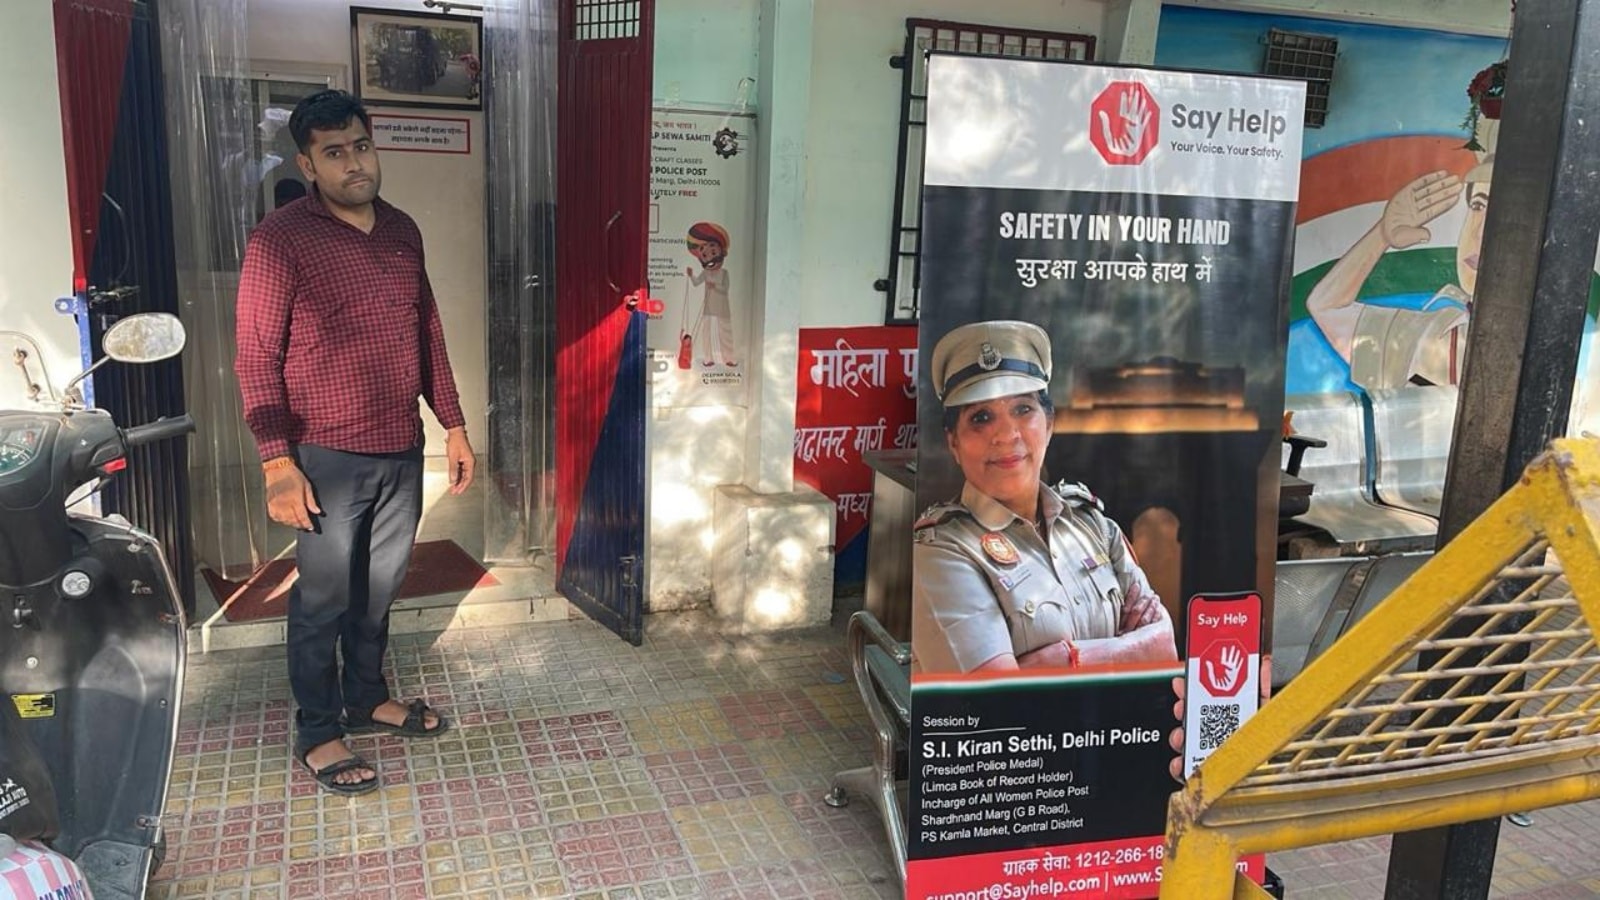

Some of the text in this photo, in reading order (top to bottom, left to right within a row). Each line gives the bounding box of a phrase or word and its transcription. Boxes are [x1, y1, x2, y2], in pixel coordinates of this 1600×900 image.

[1171, 103, 1286, 142] Say Help
[661, 131, 684, 140] SEWA
[686, 133, 711, 142] SAMITI
[654, 156, 675, 164] CRAFT
[1170, 140, 1284, 160] Your Voice. Your Safety.
[655, 166, 685, 175] POLICE
[686, 167, 708, 176] POST
[650, 189, 698, 198] LUTELY FREE
[1000, 211, 1230, 246] SAFETY IN YOUR HAND
[1015, 253, 1213, 288] सुरक्षा आपके हाथ में
[810, 337, 889, 398] महिला
[854, 417, 887, 454] मार्ग
[1197, 612, 1248, 628] Say Help
[922, 715, 980, 728] Session by
[922, 727, 1160, 758] S.I. Kiran Sethi, Delhi Police
[922, 757, 1044, 778] (President Police Medal)
[922, 770, 1073, 795] (Limca Book of Record Holder)
[921, 785, 1089, 810] Incharge of All Women Police Post
[921, 810, 983, 826] Shardhnand
[985, 808, 1011, 821] Marg
[1013, 806, 1026, 820] (G
[1028, 805, 1036, 816] B
[921, 817, 1083, 843] PS Kamla Market, Central District
[1002, 844, 1164, 876] ग्राहक सेवा: 1212-266-18
